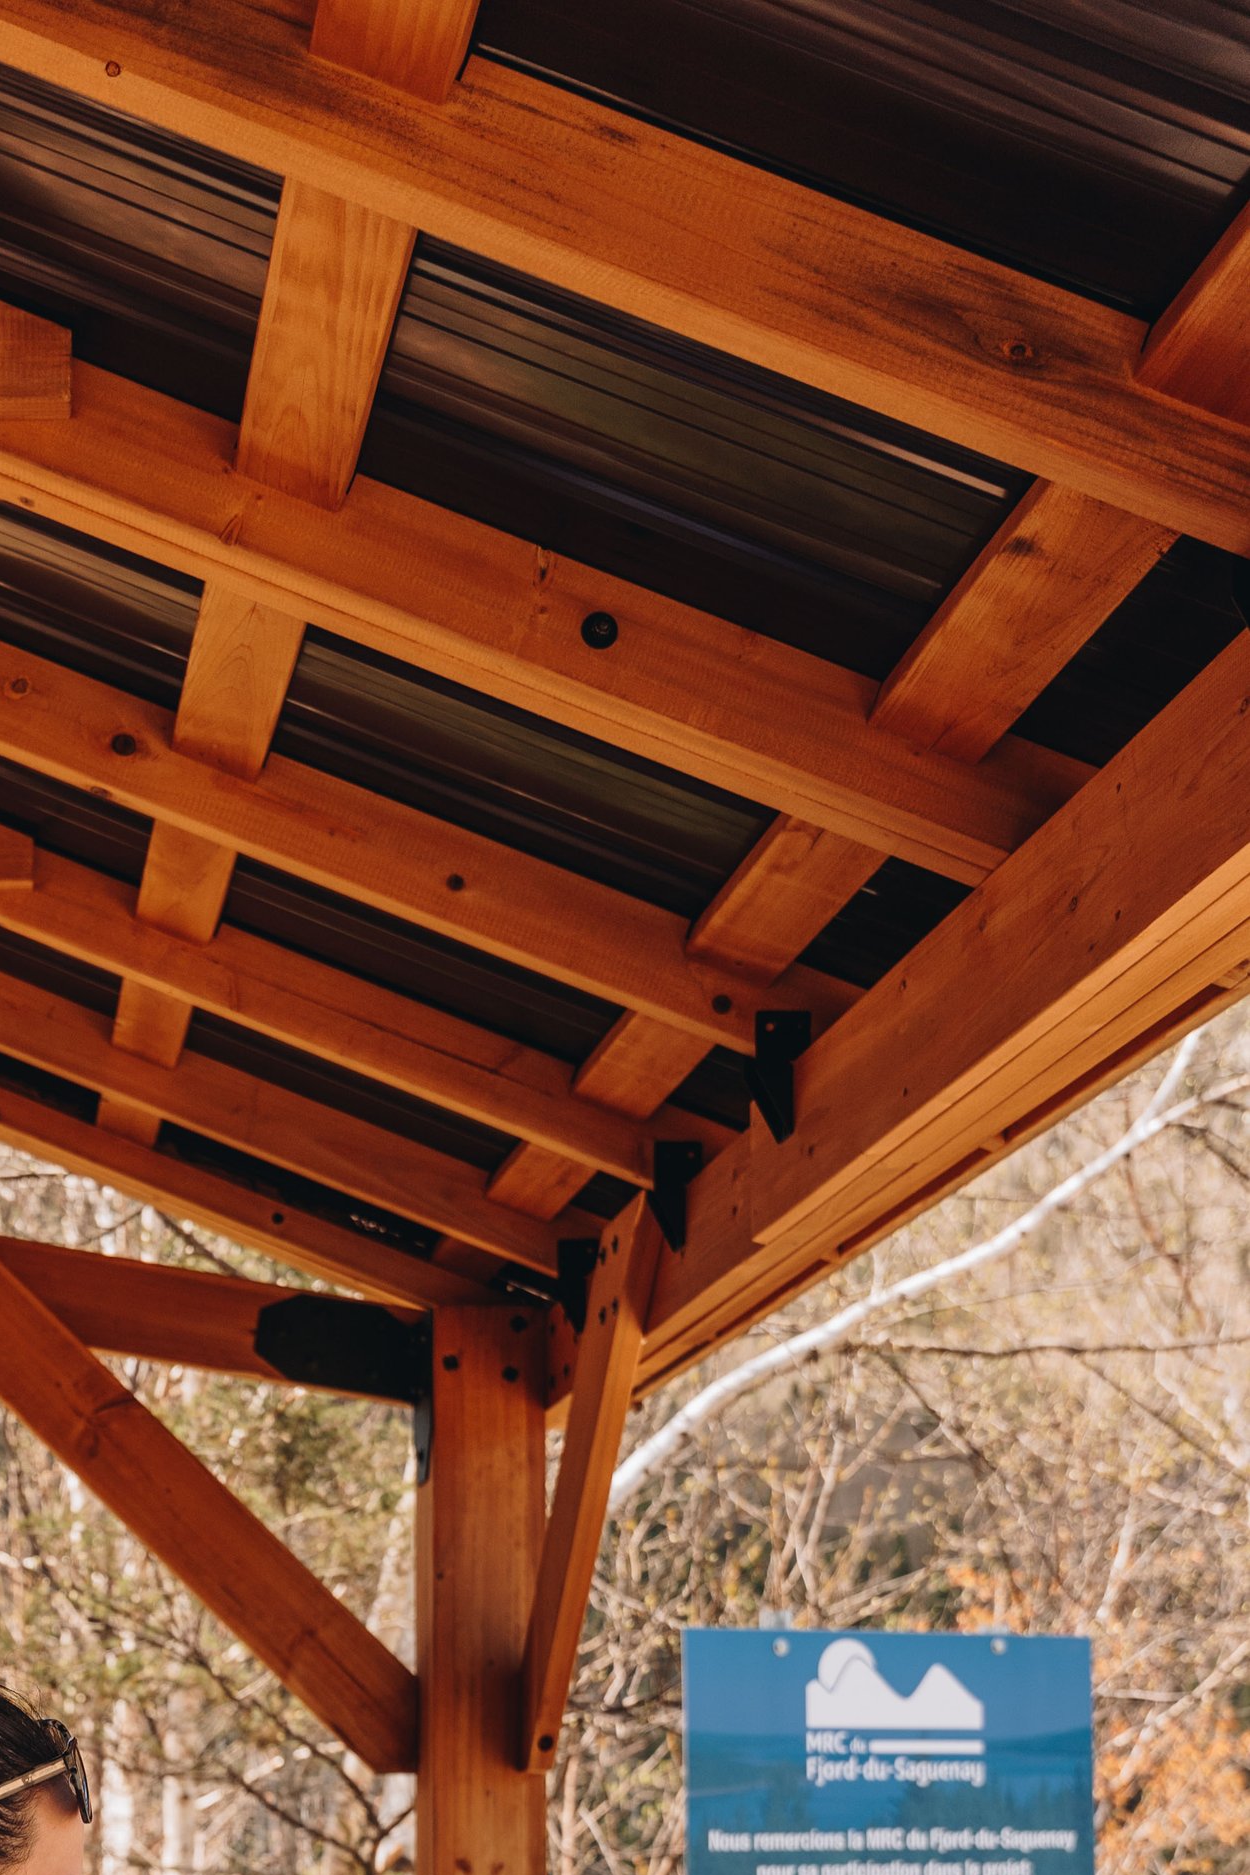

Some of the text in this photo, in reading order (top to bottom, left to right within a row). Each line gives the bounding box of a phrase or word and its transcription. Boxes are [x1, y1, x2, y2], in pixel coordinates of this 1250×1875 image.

[806, 1731, 867, 1754] MRC du
[806, 1756, 985, 1787] Fjord-du-Saguenay
[708, 1827, 1078, 1853] Nous remercions la MRC du Fjord-du-Saguenay
